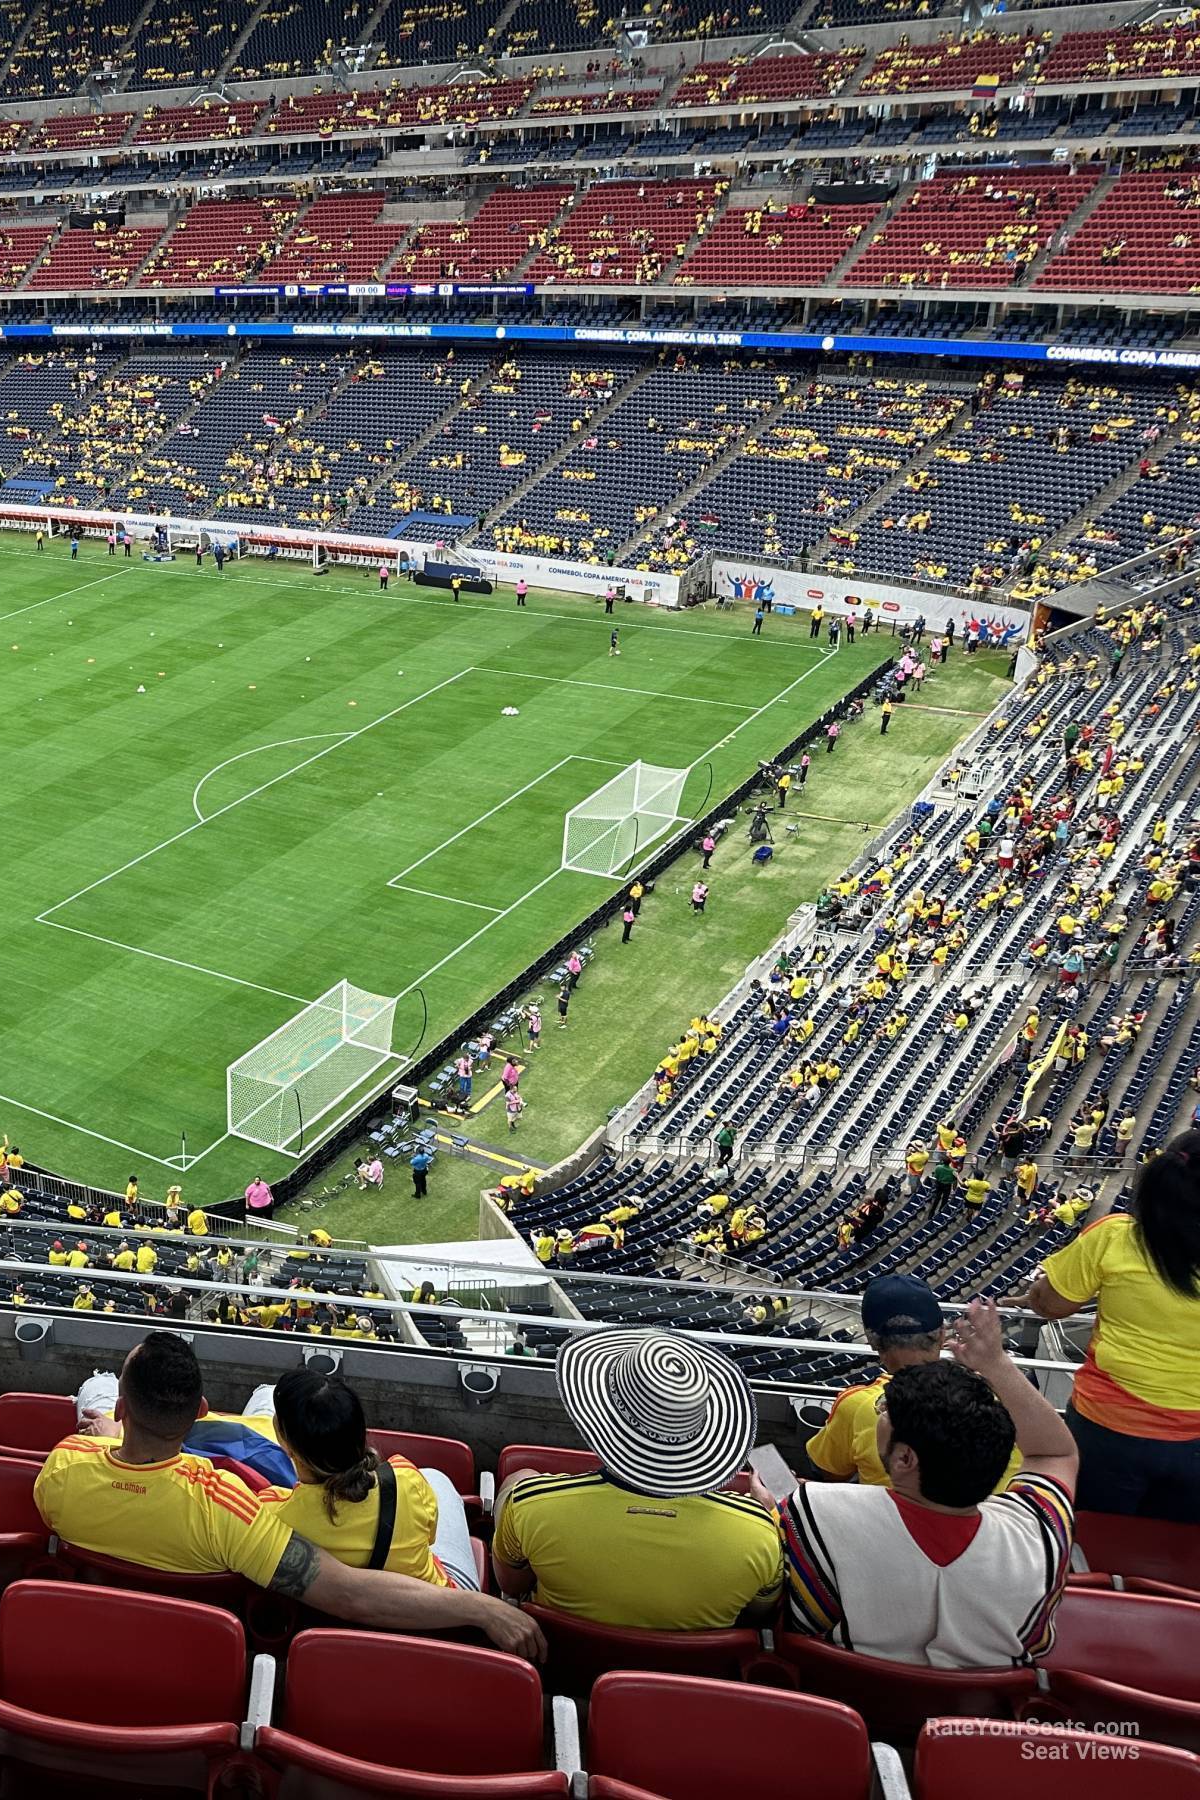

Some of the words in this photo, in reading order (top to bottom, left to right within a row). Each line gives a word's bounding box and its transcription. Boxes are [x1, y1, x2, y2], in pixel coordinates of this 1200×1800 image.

[574, 329, 626, 341] CONMEBOL
[627, 330, 652, 342] COPA
[652, 331, 696, 343] AMERICA
[717, 333, 743, 345] 2024
[1046, 346, 1119, 363] CONMEBOL
[1120, 349, 1157, 365] COPA
[509, 561, 524, 569] 2024
[548, 567, 583, 578] CONMEBOL
[583, 572, 600, 580] COPA
[601, 575, 630, 584] AMERICA
[630, 578, 643, 586] USA
[644, 580, 661, 588] 2024
[111, 1480, 147, 1495] COLOMBIA
